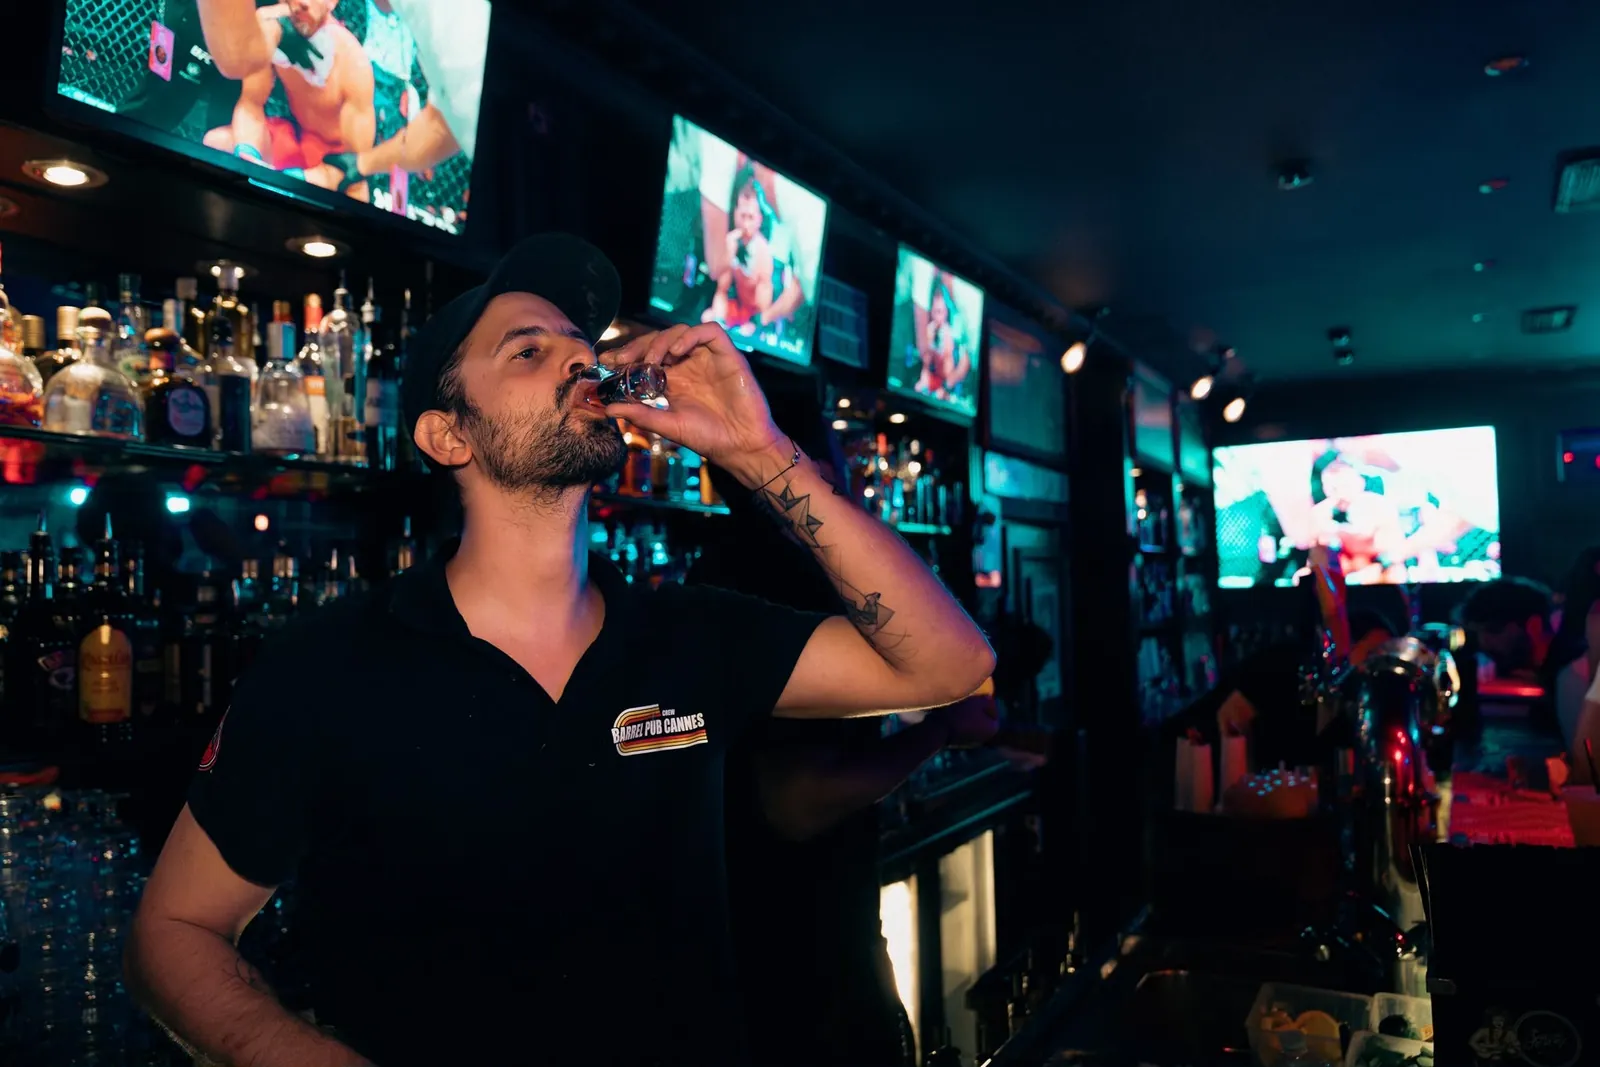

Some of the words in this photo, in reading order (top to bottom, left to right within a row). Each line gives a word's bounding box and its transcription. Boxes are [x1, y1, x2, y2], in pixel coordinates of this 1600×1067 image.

[662, 709, 675, 717] CREW
[611, 723, 643, 743] BARREL
[644, 719, 662, 736] PUB
[664, 712, 705, 734] CANNES
